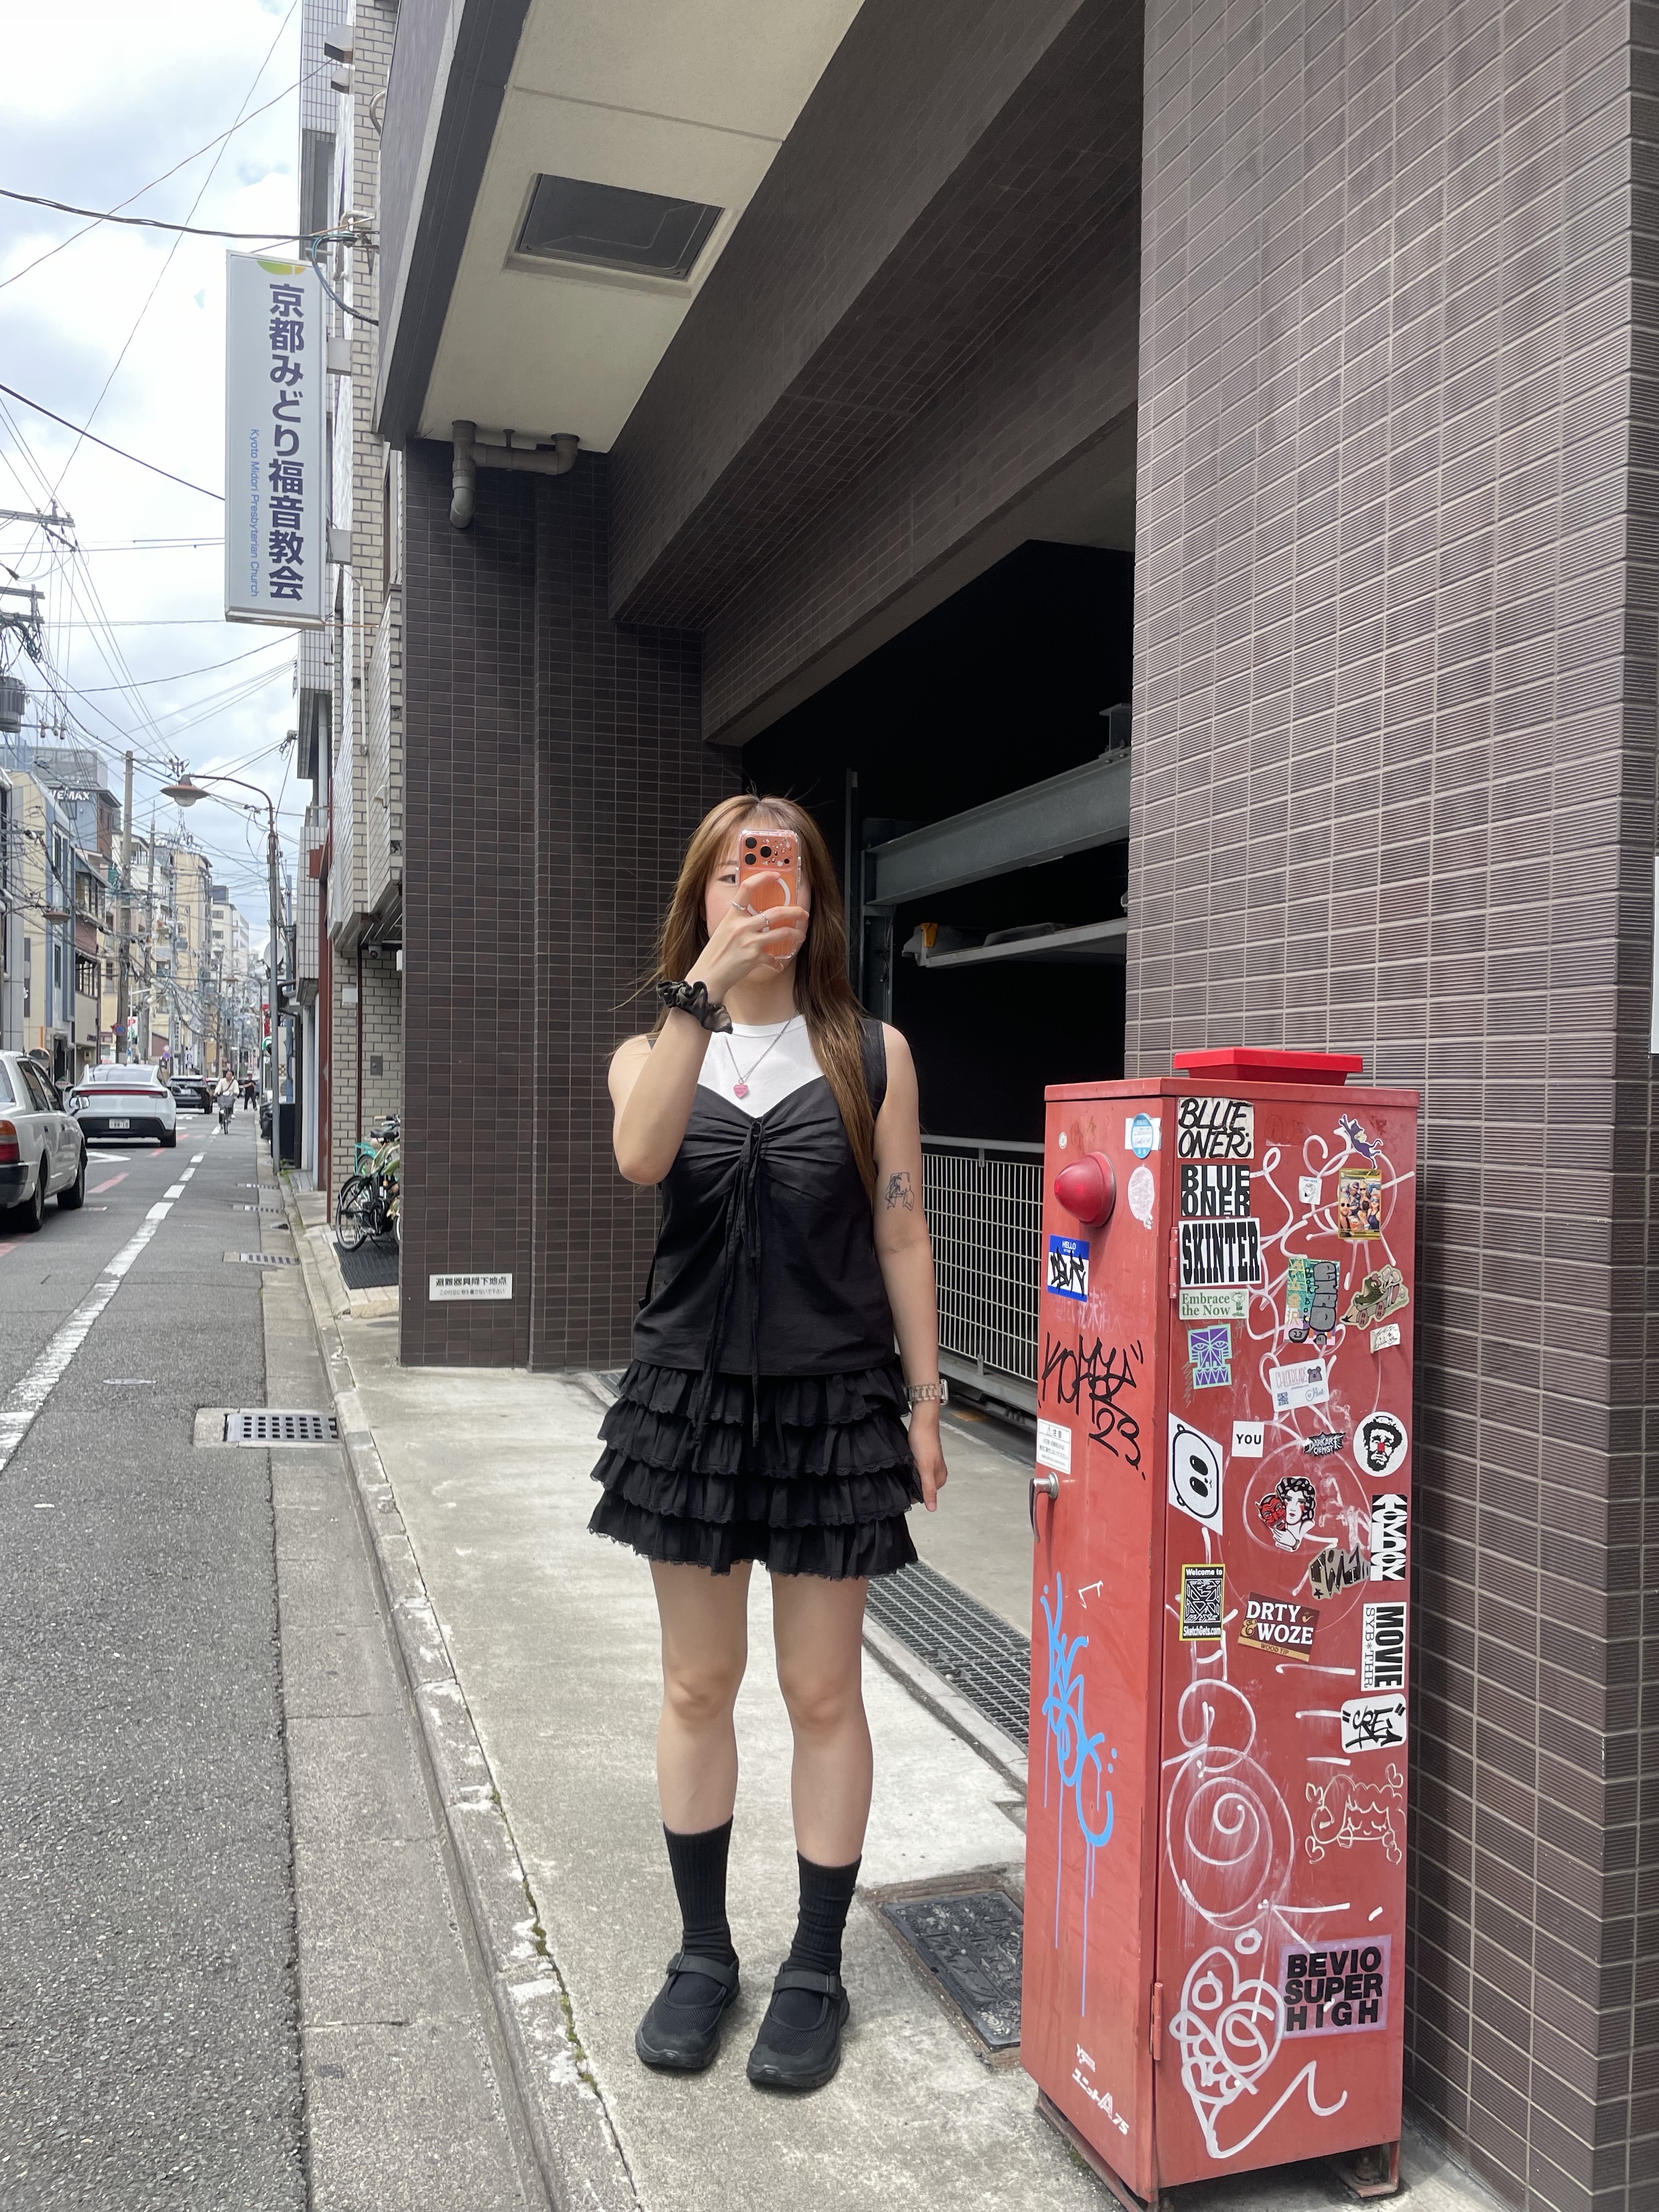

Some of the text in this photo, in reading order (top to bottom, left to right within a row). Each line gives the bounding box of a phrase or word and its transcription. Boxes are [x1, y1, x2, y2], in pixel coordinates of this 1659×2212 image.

[268, 284, 304, 601] 京都みどり福音教会
[250, 429, 259, 597] Kyoto Midori Presbyterian Church
[1178, 1098, 1251, 1129] BLUE
[1182, 1164, 1250, 1191] BLUE
[1182, 1190, 1250, 1216] ONER
[1062, 1240, 1076, 1250] HELLO
[1182, 1221, 1260, 1284] SKINTER
[1182, 1293, 1229, 1304] Embrace
[1182, 1304, 1231, 1316] the Now
[1235, 1434, 1261, 1444] YOU
[1246, 1600, 1301, 1622] DRTY
[1241, 1619, 1314, 1645] & WOZE
[1261, 1643, 1279, 1652] WOOD
[1374, 1606, 1404, 1687] MOVIE
[1287, 1946, 1381, 1979] BEVIO
[1284, 1973, 1383, 2005] SUPER
[1286, 1999, 1378, 2032] HIGH
